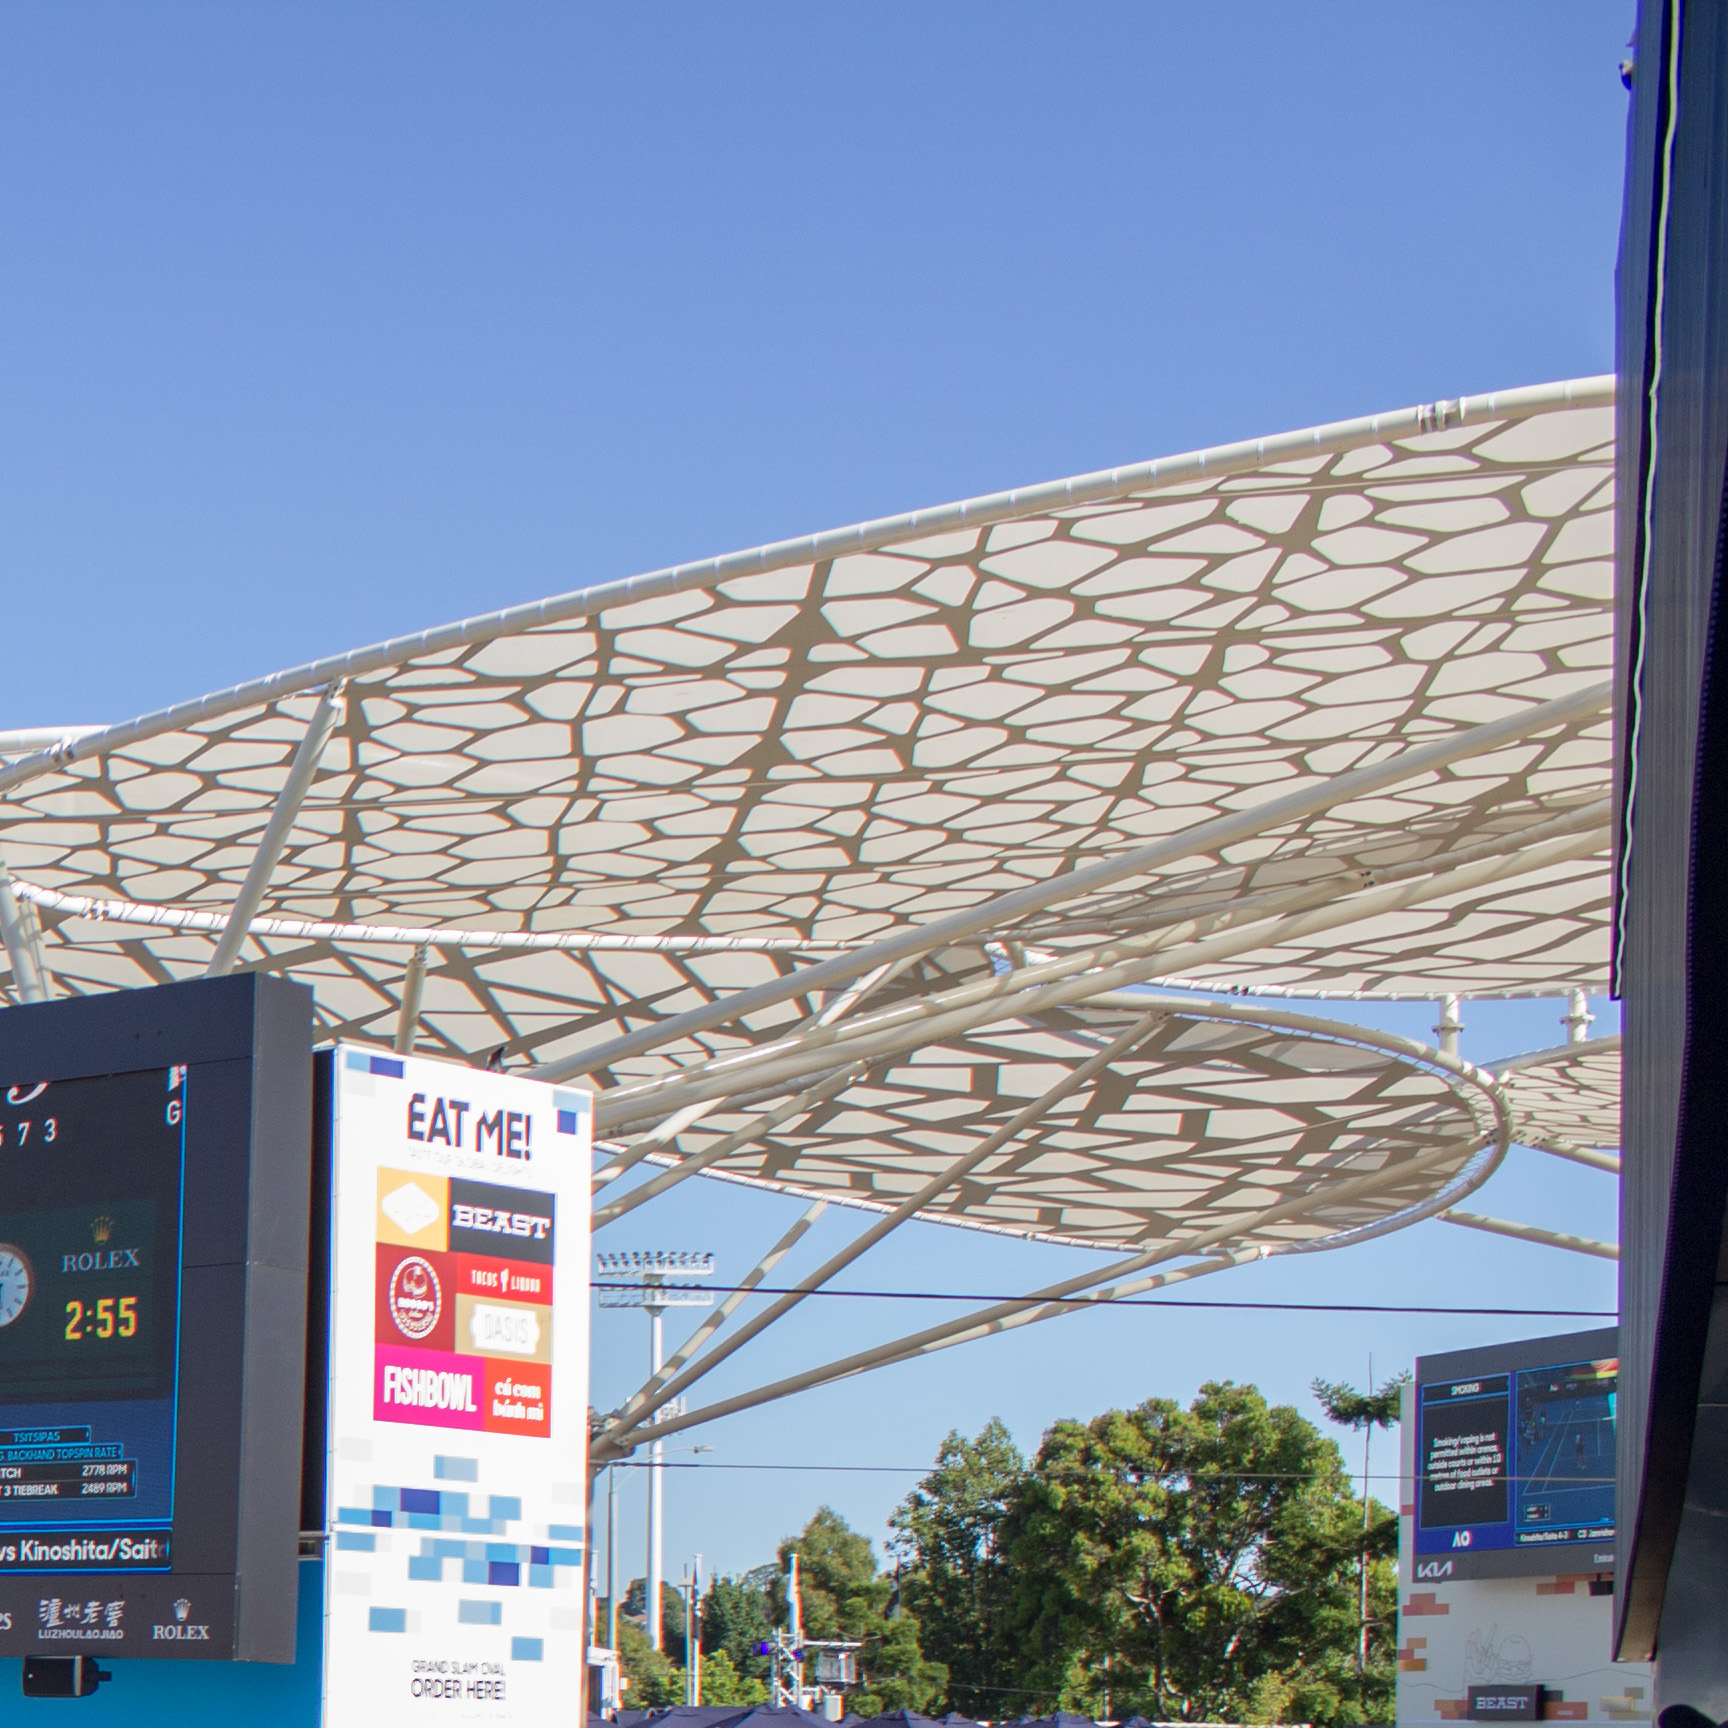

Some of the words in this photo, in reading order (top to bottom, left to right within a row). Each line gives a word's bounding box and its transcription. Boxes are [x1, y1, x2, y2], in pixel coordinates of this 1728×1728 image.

[407, 1092, 470, 1147] EAT
[475, 1109, 532, 1161] ME!
[452, 1204, 551, 1239] BEAST
[61, 1248, 141, 1272] ROLEX
[64, 1296, 138, 1340] 2:55
[484, 1313, 528, 1344] OASIS
[383, 1365, 477, 1412] FISHBOWL
[14, 1431, 61, 1443] TSITSIPAS
[7, 1450, 55, 1461] BACKHAND
[57, 1447, 93, 1459] TOPSPIN
[94, 1446, 118, 1458] RATE
[4, 1485, 11, 1496] 3
[13, 1484, 60, 1496] TIEBREAK
[37, 1628, 124, 1640] LUZHOULAOJIAO
[152, 1625, 210, 1640] ROLEX
[410, 1678, 462, 1699] ORDER
[1476, 1696, 1528, 1710] BEAST
